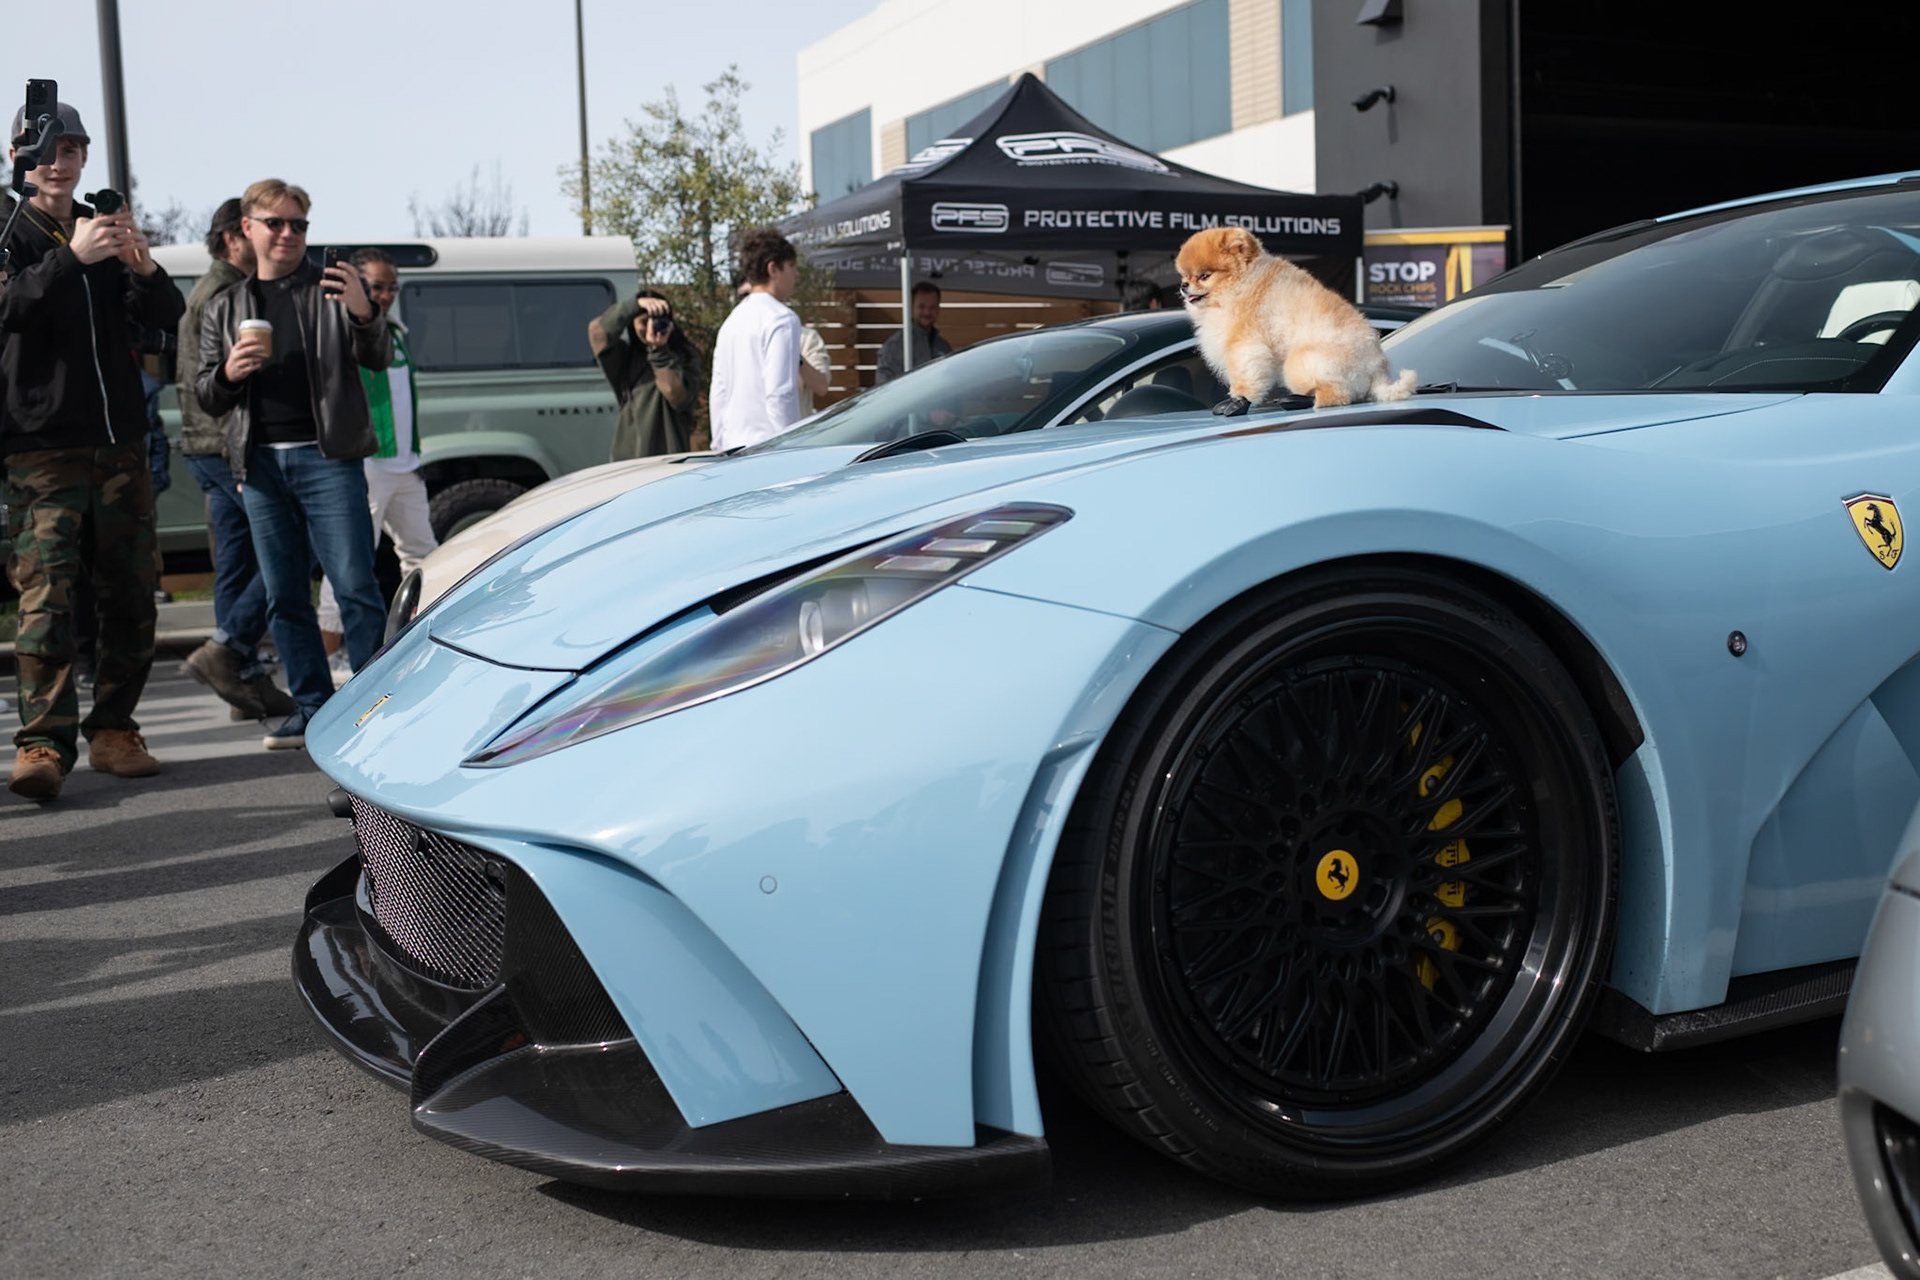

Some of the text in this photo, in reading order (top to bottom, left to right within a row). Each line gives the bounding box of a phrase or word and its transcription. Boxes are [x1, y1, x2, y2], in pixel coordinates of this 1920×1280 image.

[837, 210, 891, 240] SOLUTIONS
[932, 203, 1009, 231] PFS
[1024, 209, 1341, 235] PROTECTIVE FILM SOLUTIONS
[1369, 261, 1437, 283] STOP
[1368, 282, 1437, 295] ROCK CHIPS
[537, 405, 615, 417] HIMALAY
[1102, 872, 1129, 1007] MICHELIN
